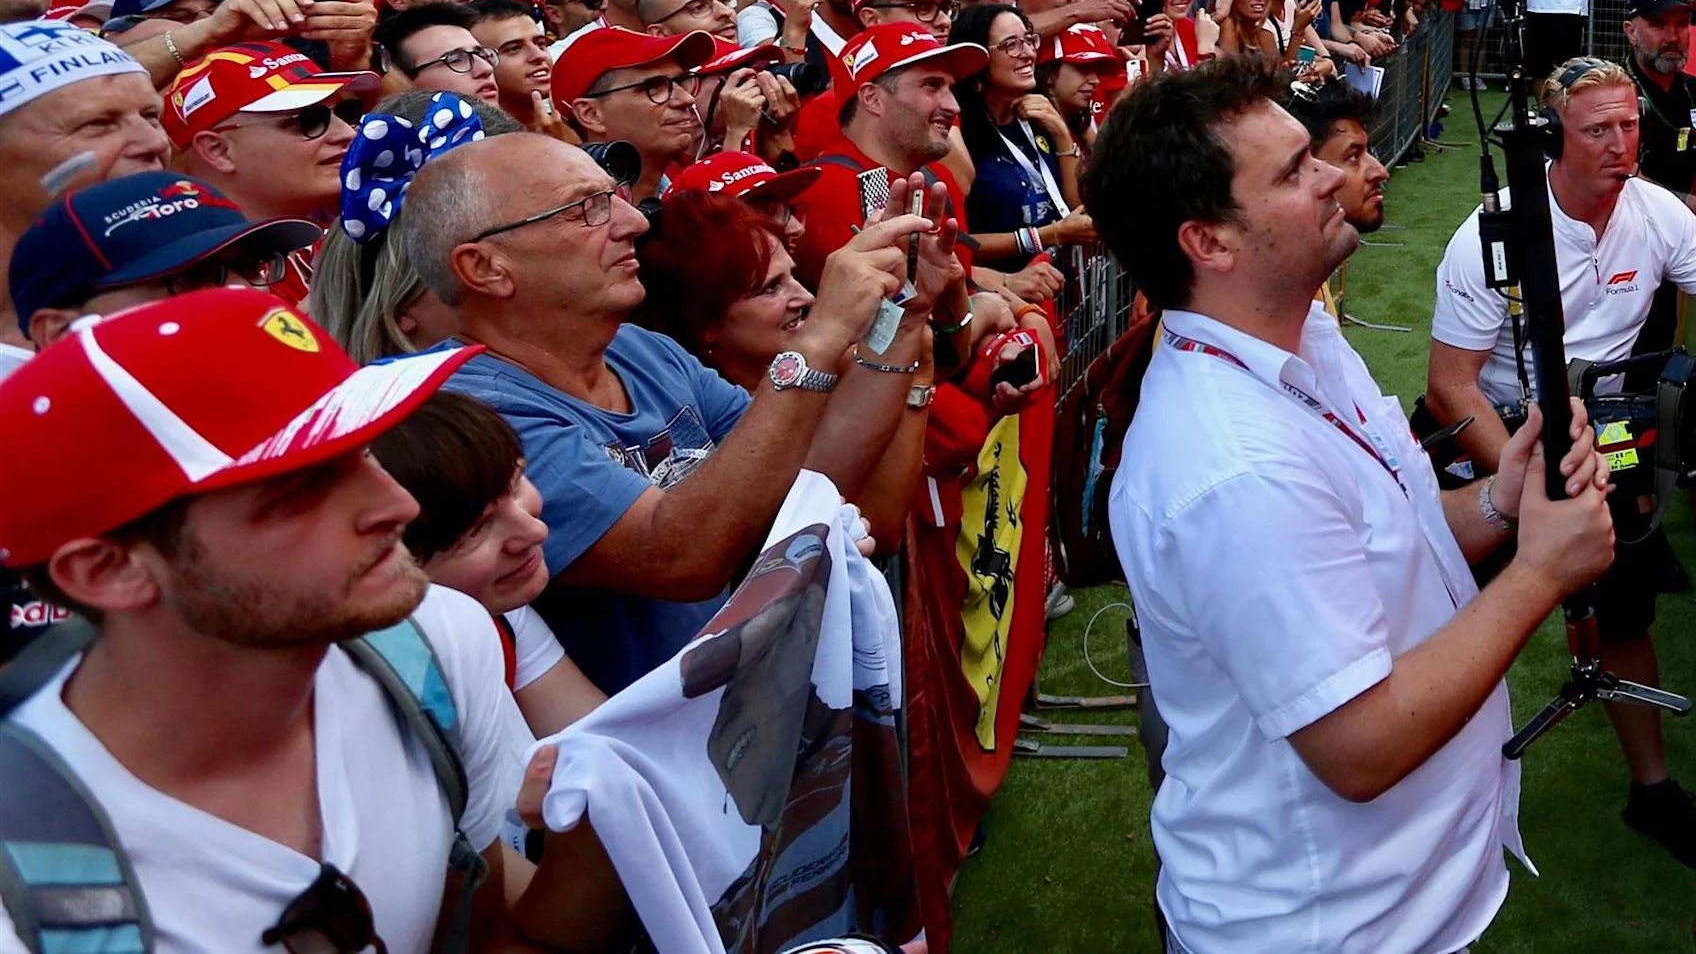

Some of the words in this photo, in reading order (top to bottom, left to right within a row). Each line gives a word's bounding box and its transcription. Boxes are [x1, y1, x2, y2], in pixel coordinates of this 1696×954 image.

[29, 50, 132, 84] FINLAN
[104, 195, 162, 224] SCUDERIA
[1606, 285, 1632, 295] Formula
